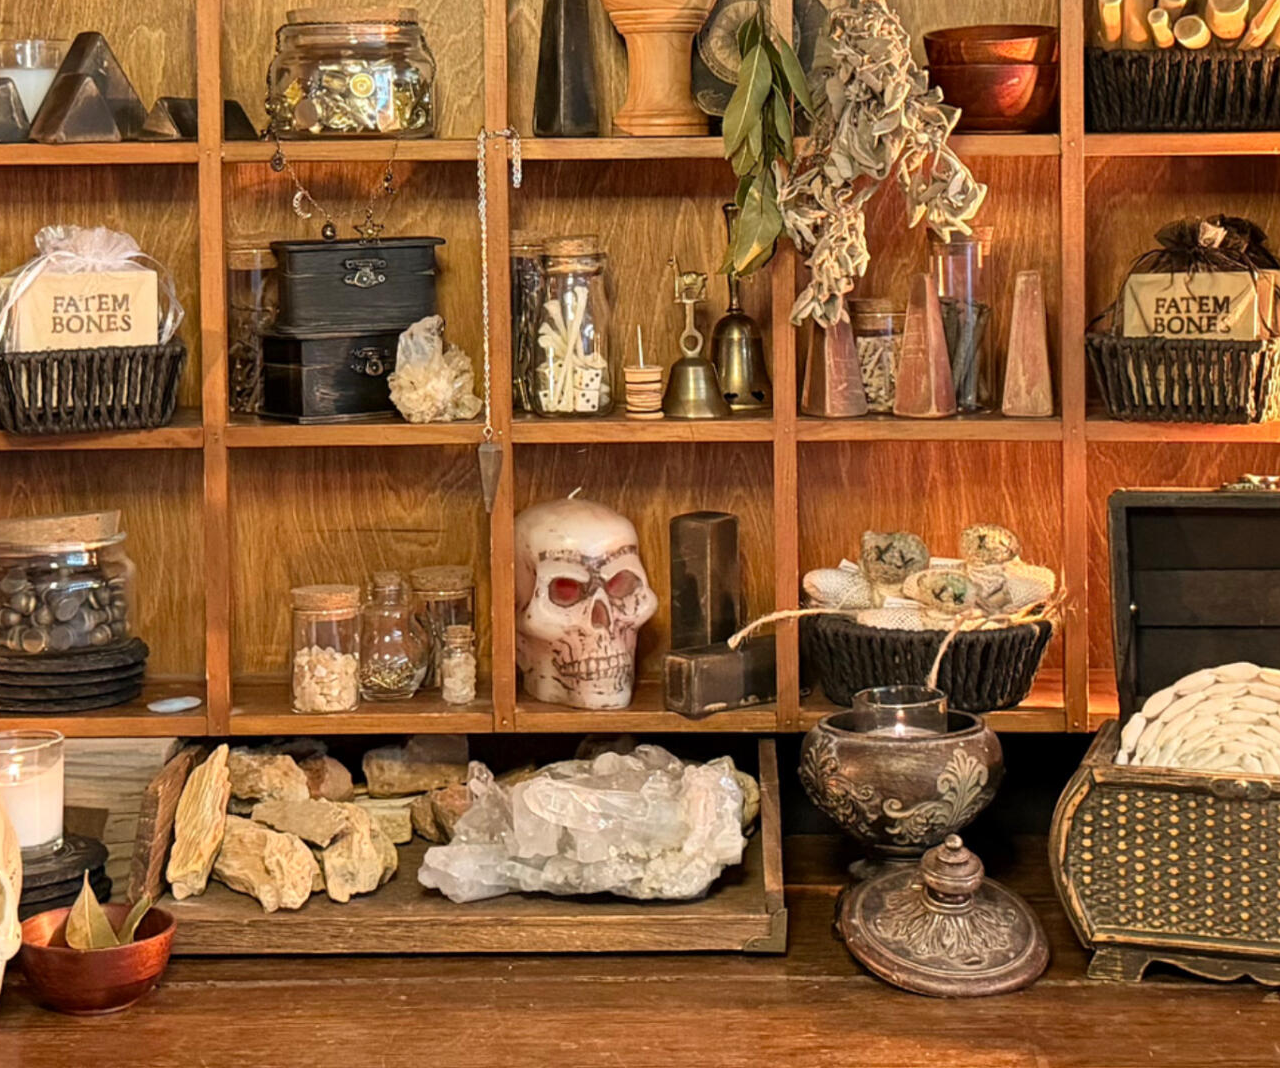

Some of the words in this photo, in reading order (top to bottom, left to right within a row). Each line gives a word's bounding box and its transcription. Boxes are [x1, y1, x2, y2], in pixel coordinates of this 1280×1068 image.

[52, 293, 130, 313] FATEM
[1154, 295, 1231, 315] FATEM
[51, 314, 132, 333] BONES
